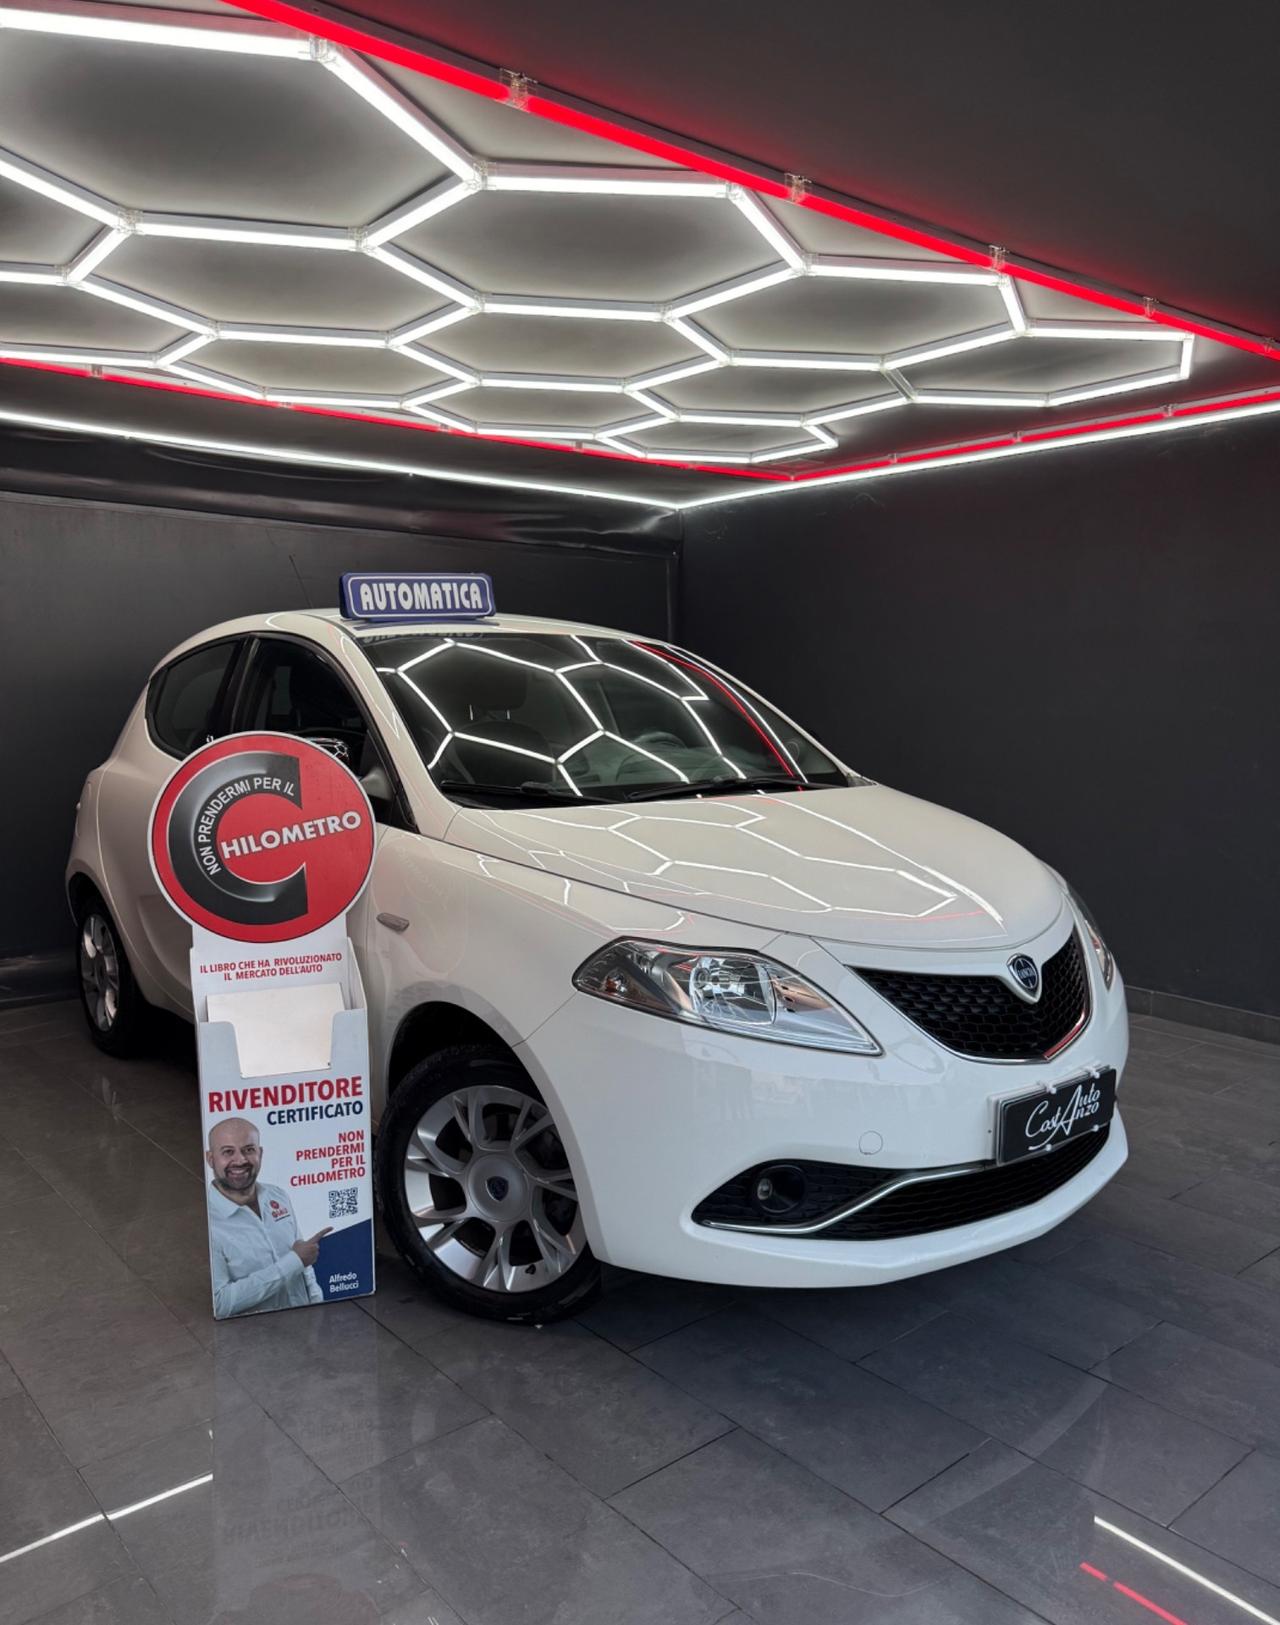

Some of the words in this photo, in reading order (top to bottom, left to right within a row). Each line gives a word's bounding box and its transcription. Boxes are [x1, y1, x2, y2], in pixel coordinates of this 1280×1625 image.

[360, 582, 483, 611] AUTOMATICA
[253, 777, 281, 792] PER
[283, 781, 295, 797] IL
[198, 780, 251, 843] PRENDERMI
[198, 847, 221, 876] NON
[200, 965, 208, 974] IL
[210, 962, 237, 973] LIBRO
[238, 960, 256, 970] CHE
[258, 958, 271, 968] HA
[274, 952, 343, 967] RIVOLUZIONATO
[224, 972, 233, 981] IL
[236, 968, 277, 980] MERCATO
[279, 963, 323, 977] DELL'AUTO
[208, 1076, 363, 1113] RIVENDITORE
[267, 1100, 363, 1126] CERTIFICATO
[338, 1130, 364, 1144] NON
[296, 1142, 365, 1162] PRENDERMI
[331, 1156, 353, 1169] PER
[356, 1155, 366, 1166] IL
[290, 1166, 366, 1187] CHILOMETRO
[329, 1272, 358, 1284] Alfredo
[329, 1280, 360, 1293] Bellucci
